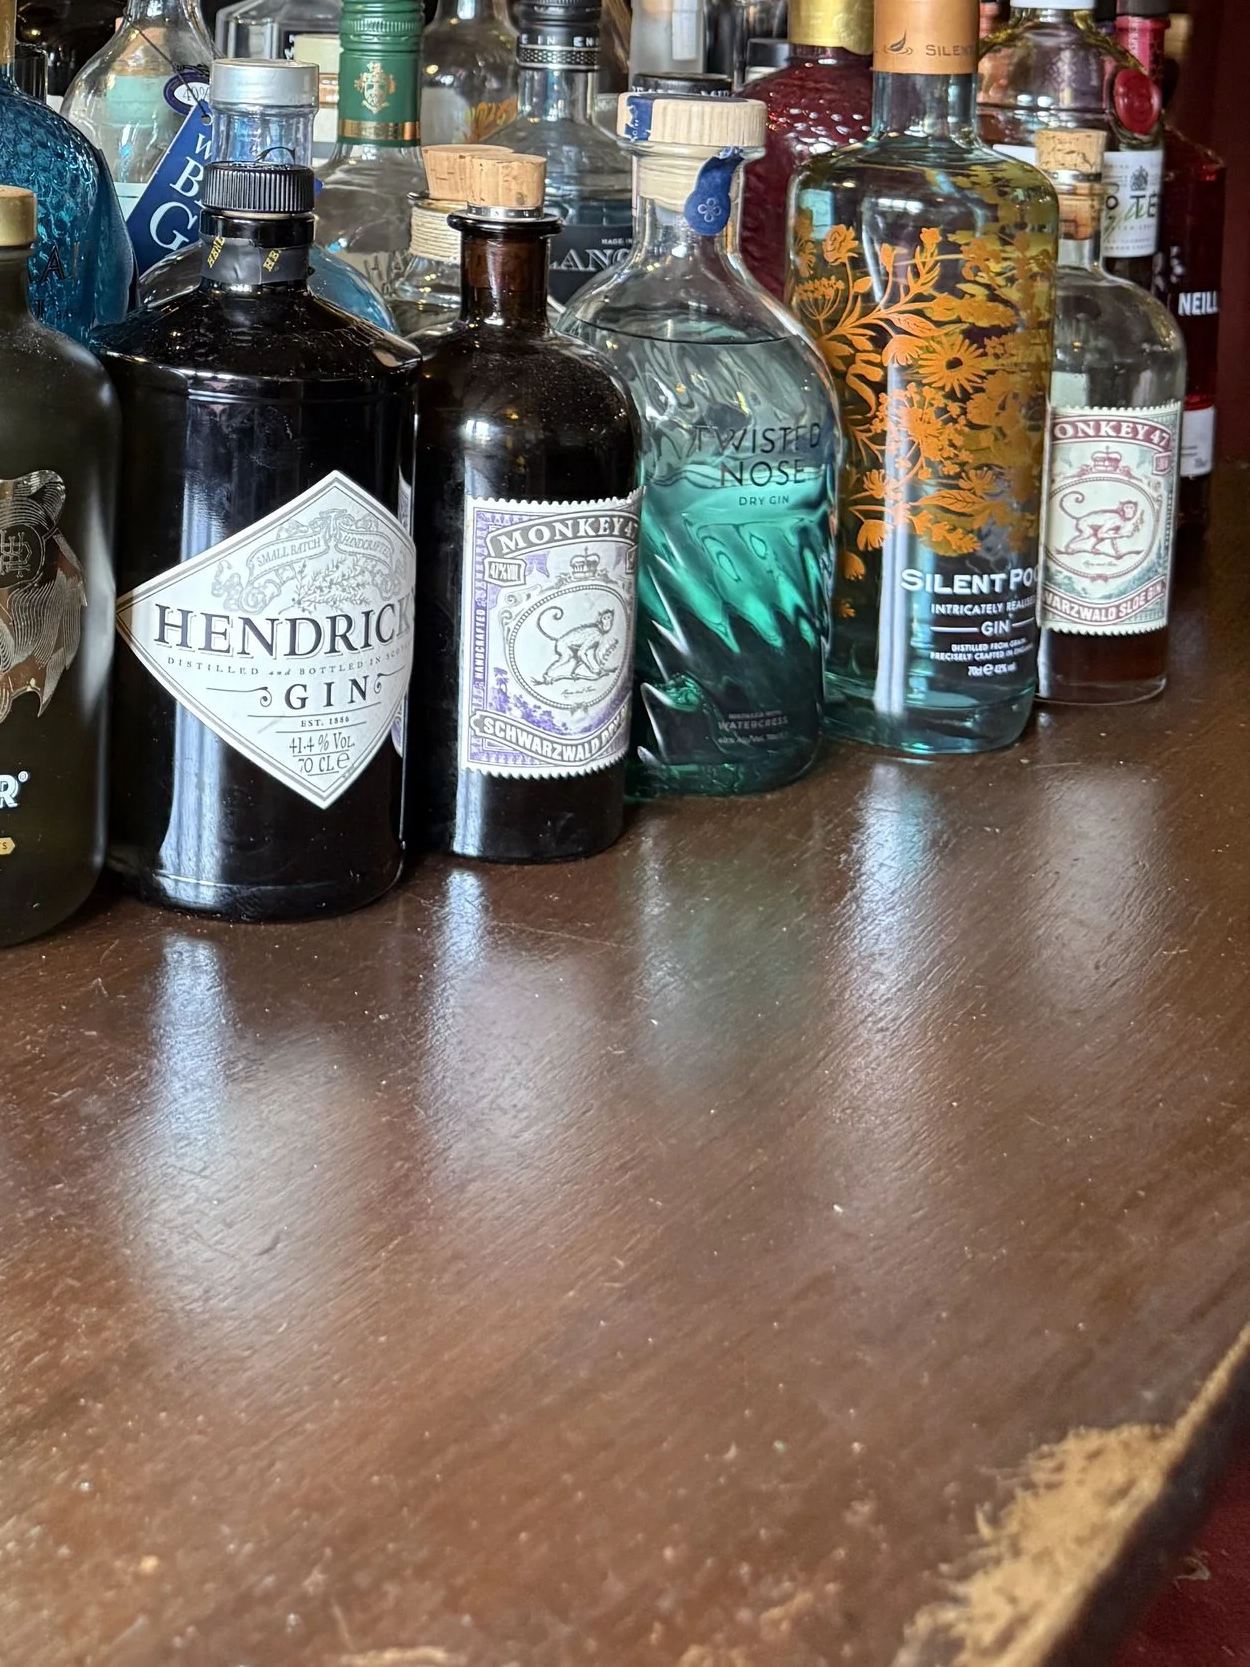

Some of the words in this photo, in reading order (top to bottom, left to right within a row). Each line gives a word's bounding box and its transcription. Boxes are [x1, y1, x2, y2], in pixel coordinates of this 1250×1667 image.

[1150, 429, 1170, 446] 47
[720, 459, 807, 487] NOSE
[739, 496, 767, 506] DRY
[769, 496, 789, 505] GIN
[498, 517, 625, 554] MONKEY
[256, 549, 289, 567] SMALL
[290, 536, 321, 555] BATCH
[901, 569, 1007, 595] SILENT
[931, 602, 1004, 615] INTRICATELY
[1119, 591, 1146, 616] SLOE
[981, 620, 1012, 636] GIN
[473, 609, 486, 679] HANDCRAFTED
[167, 656, 259, 675] DISTILLED
[299, 662, 364, 675] BOTTLED
[369, 656, 381, 666] IN
[930, 651, 973, 661] PRECISELY
[284, 674, 370, 710] GIN
[300, 718, 325, 727] EST.
[329, 716, 350, 725] 1886
[718, 716, 789, 731] WATERCRESS
[483, 718, 599, 763] SCHWARZWALD
[297, 757, 313, 773] 70
